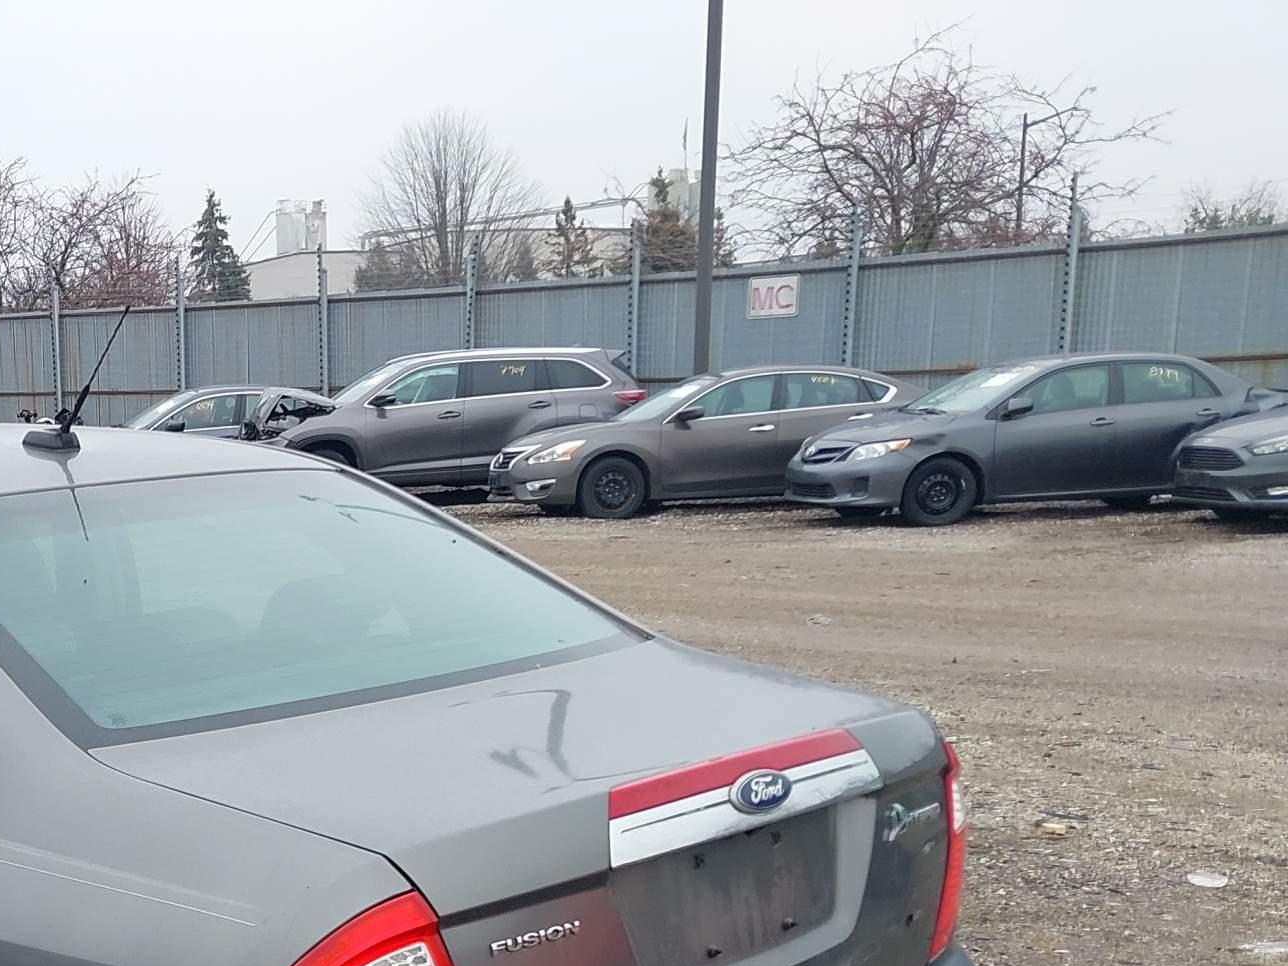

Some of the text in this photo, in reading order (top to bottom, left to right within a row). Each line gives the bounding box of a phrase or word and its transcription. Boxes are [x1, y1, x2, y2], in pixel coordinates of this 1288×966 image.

[752, 284, 794, 311] MC
[750, 775, 785, 804] Ford
[489, 920, 581, 957] FUSION
